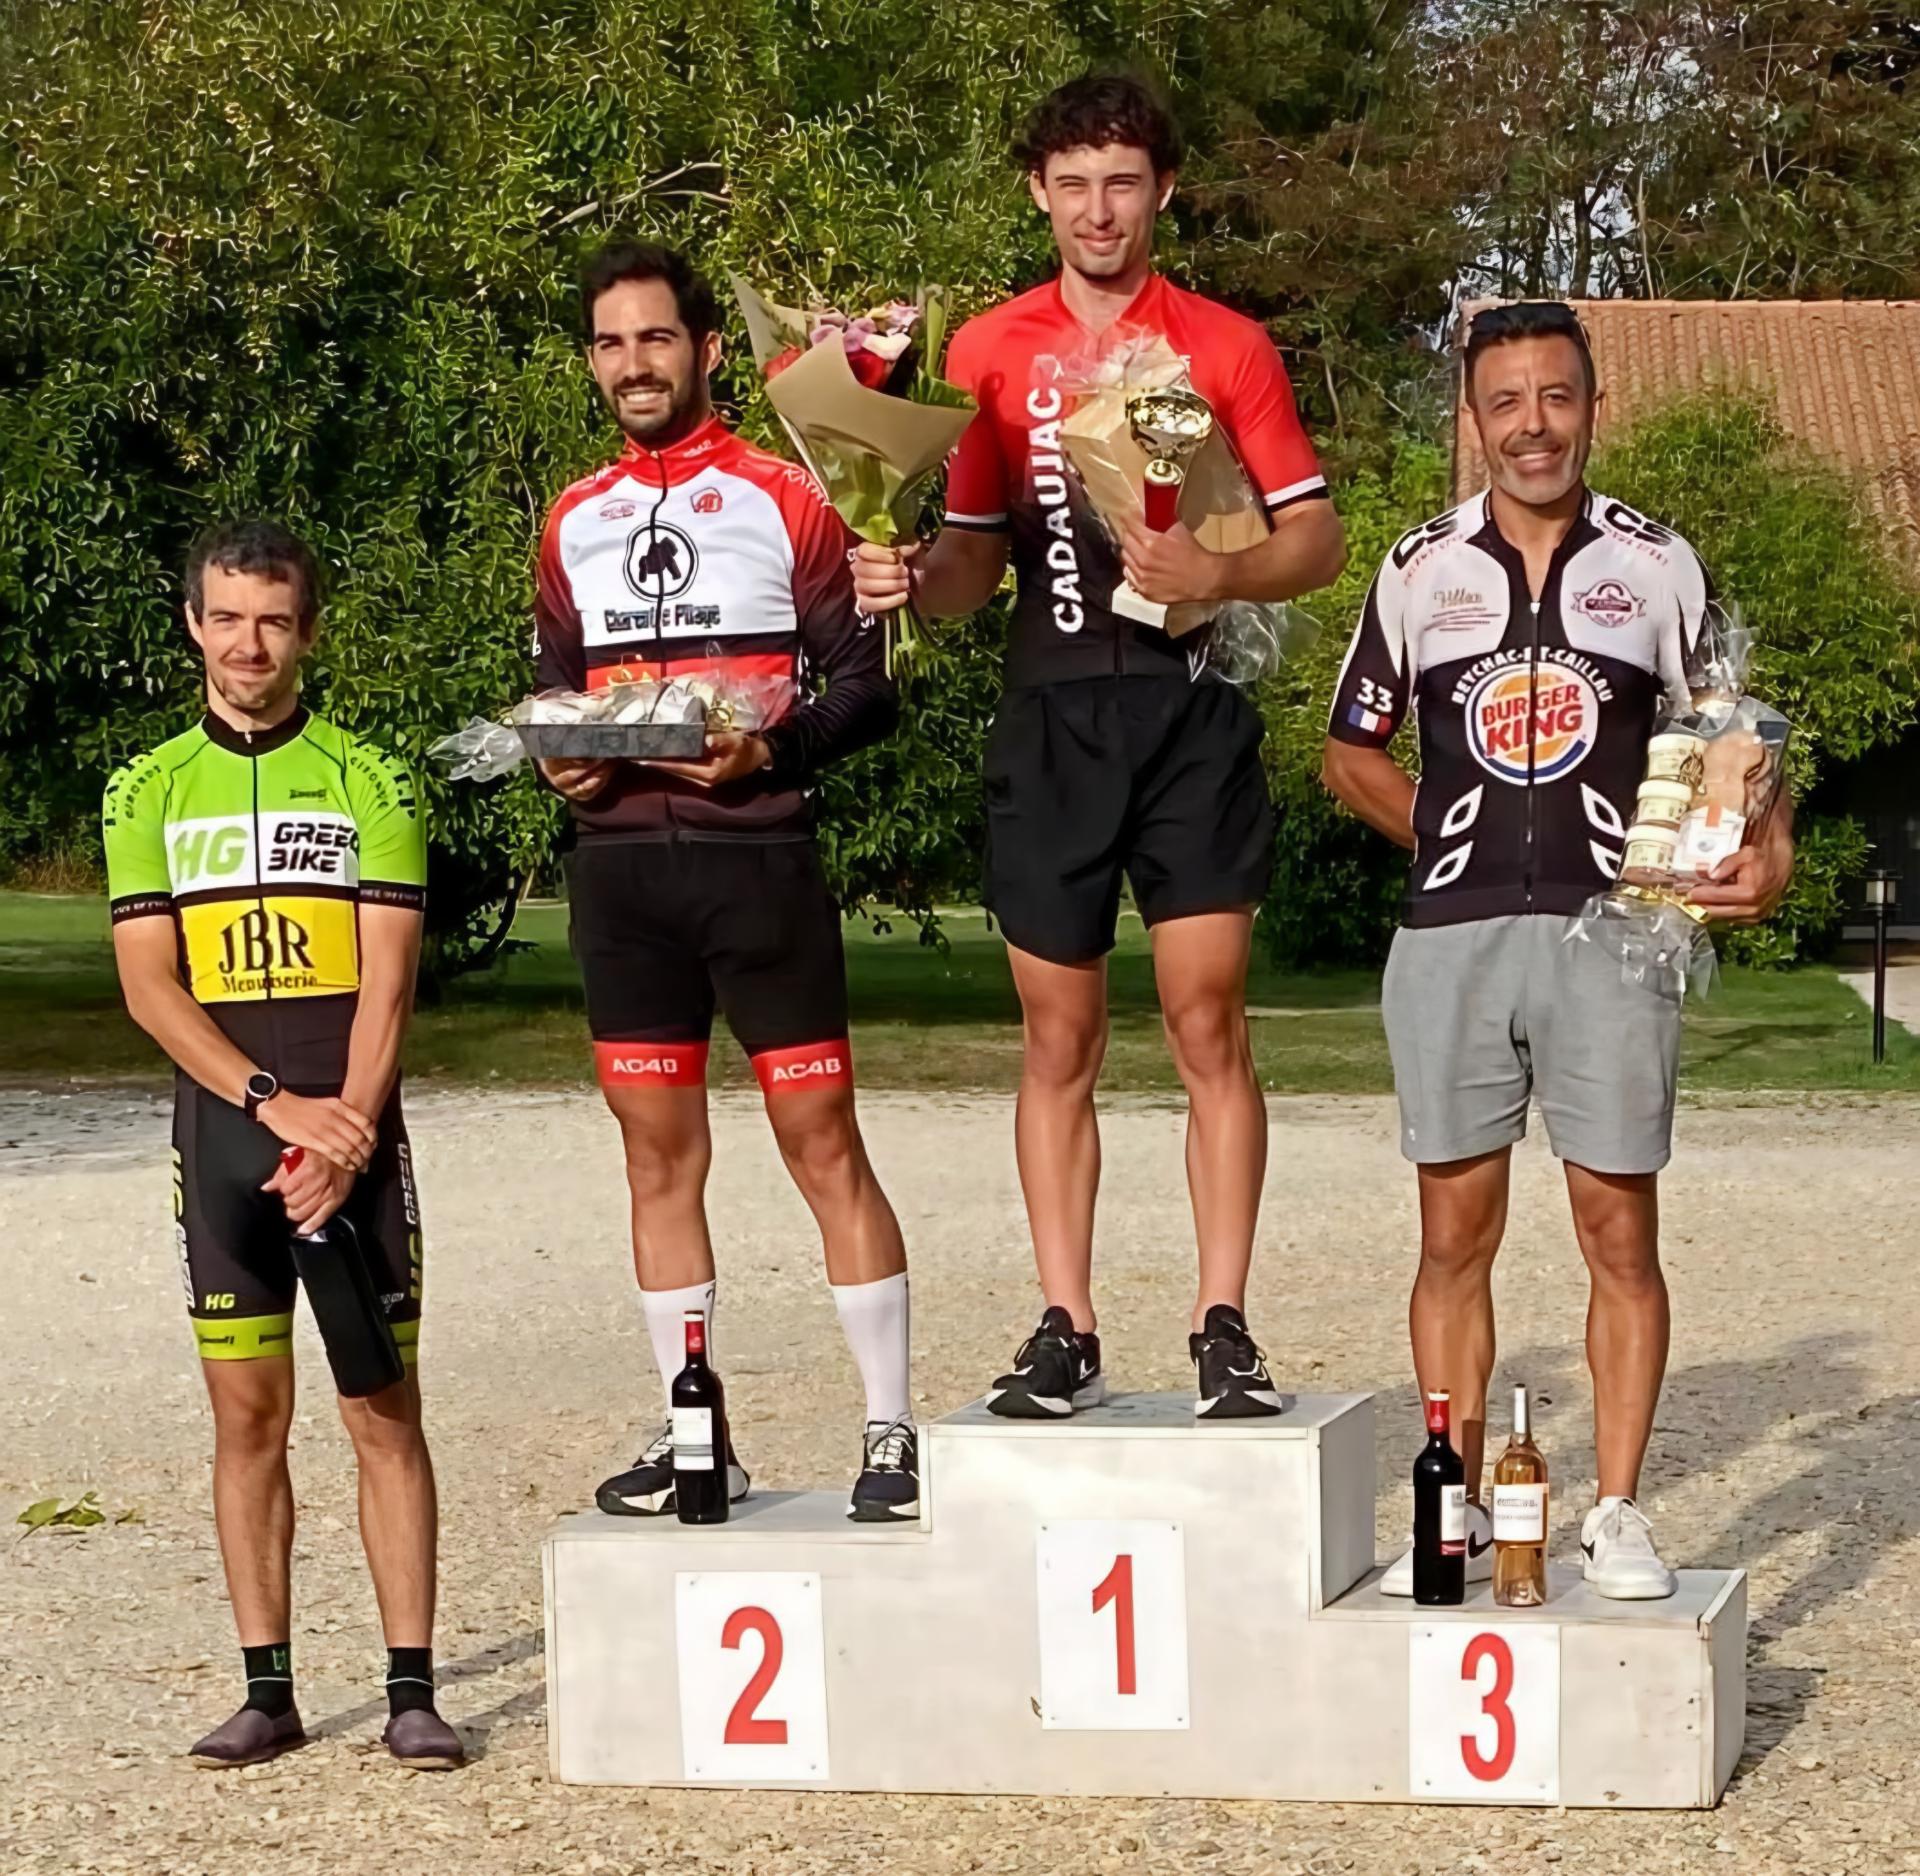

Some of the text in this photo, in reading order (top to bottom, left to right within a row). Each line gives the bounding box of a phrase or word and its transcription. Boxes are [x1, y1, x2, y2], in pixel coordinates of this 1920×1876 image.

[1026, 387, 1085, 633] CADAUJAC
[1356, 677, 1393, 713] 33
[1481, 684, 1581, 727] BURGER
[1486, 703, 1584, 757] KING
[173, 826, 248, 882] HG
[267, 848, 340, 873] BIKE
[218, 908, 316, 974] JBR
[773, 1058, 841, 1083] AC4B
[205, 1293, 235, 1310] HG
[1092, 1554, 1136, 1694] 1
[721, 1605, 788, 1744] 2
[1460, 1632, 1515, 1781] 3
